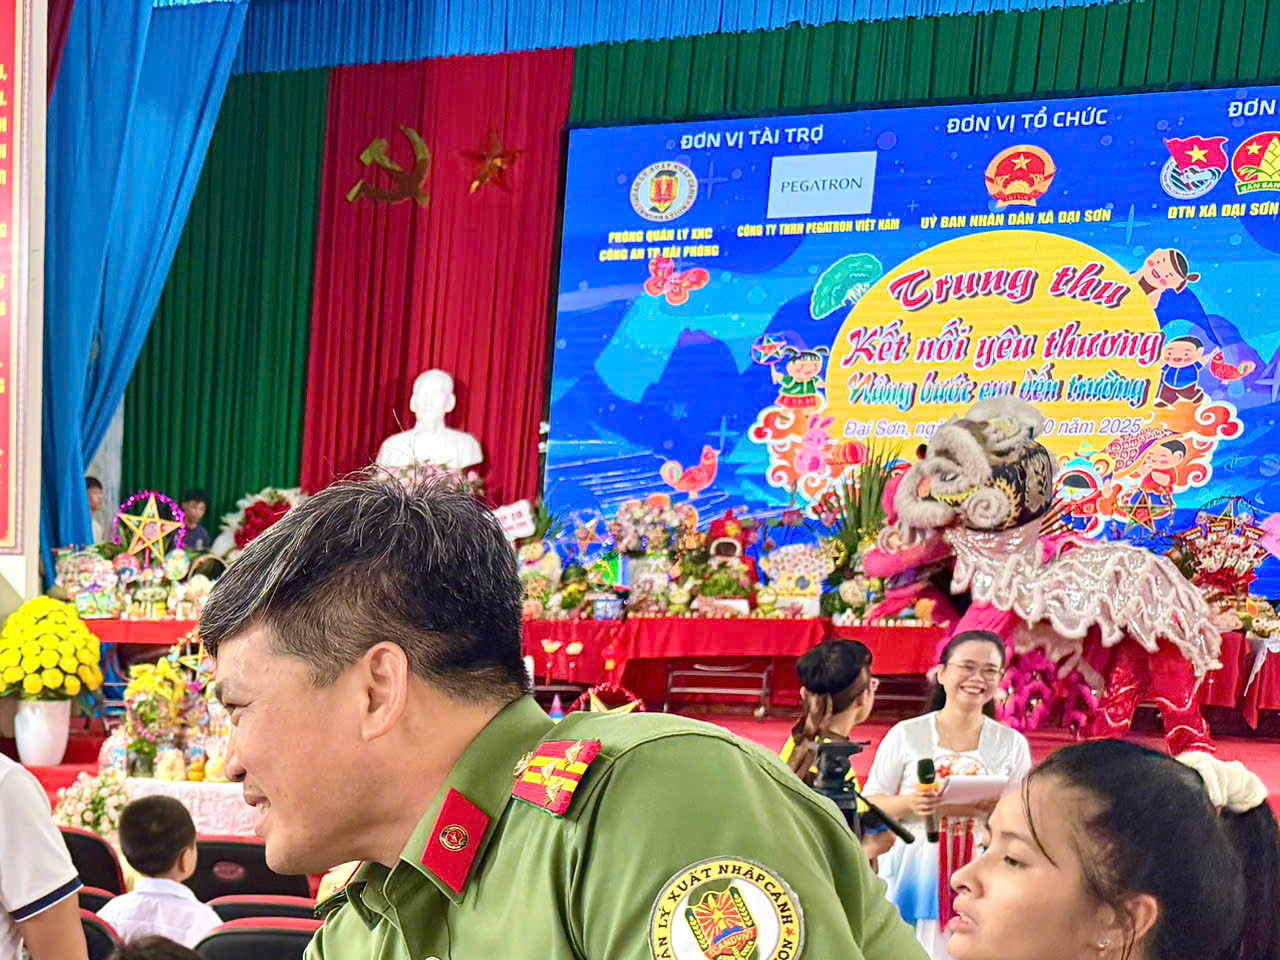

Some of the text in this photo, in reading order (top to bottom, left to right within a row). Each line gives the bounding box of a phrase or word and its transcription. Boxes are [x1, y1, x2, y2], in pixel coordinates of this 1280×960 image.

[1228, 98, 1277, 118] ĐƠN
[946, 106, 1109, 134] ĐƠN VỊ TỔ CHỨC
[680, 124, 824, 150] ĐƠN VỊ TÀI TRỢ
[780, 177, 863, 193] PEGATRON
[940, 215, 967, 229] BAN
[969, 211, 1004, 227] NHÂN
[1008, 211, 1035, 226] DÂN
[1084, 207, 1112, 223] SƠN
[1249, 200, 1280, 216] SƠN
[608, 230, 644, 244] PHÒNG
[645, 227, 675, 243] QUẢN
[677, 227, 689, 241] LÝ
[737, 218, 900, 237] CÔNG TY TNHH PEGATRON VIỆT NAM
[599, 247, 628, 262] CÔNG
[630, 248, 645, 260] AN
[662, 244, 681, 259] HẢI
[683, 244, 719, 258] PHÒNG
[888, 262, 1131, 312] Trung thu
[840, 317, 1166, 371] Kết nối yêu thương
[919, 370, 977, 405] bước
[1019, 362, 1064, 403] đến
[1067, 369, 1151, 409] trường
[844, 419, 871, 437] Đại
[1058, 418, 1095, 435] năm
[1099, 417, 1144, 436] 2025
[658, 907, 671, 929] LÝ
[667, 867, 712, 903] XUẤT
[718, 864, 766, 883] NHẬP
[764, 881, 794, 925] CẢNH
